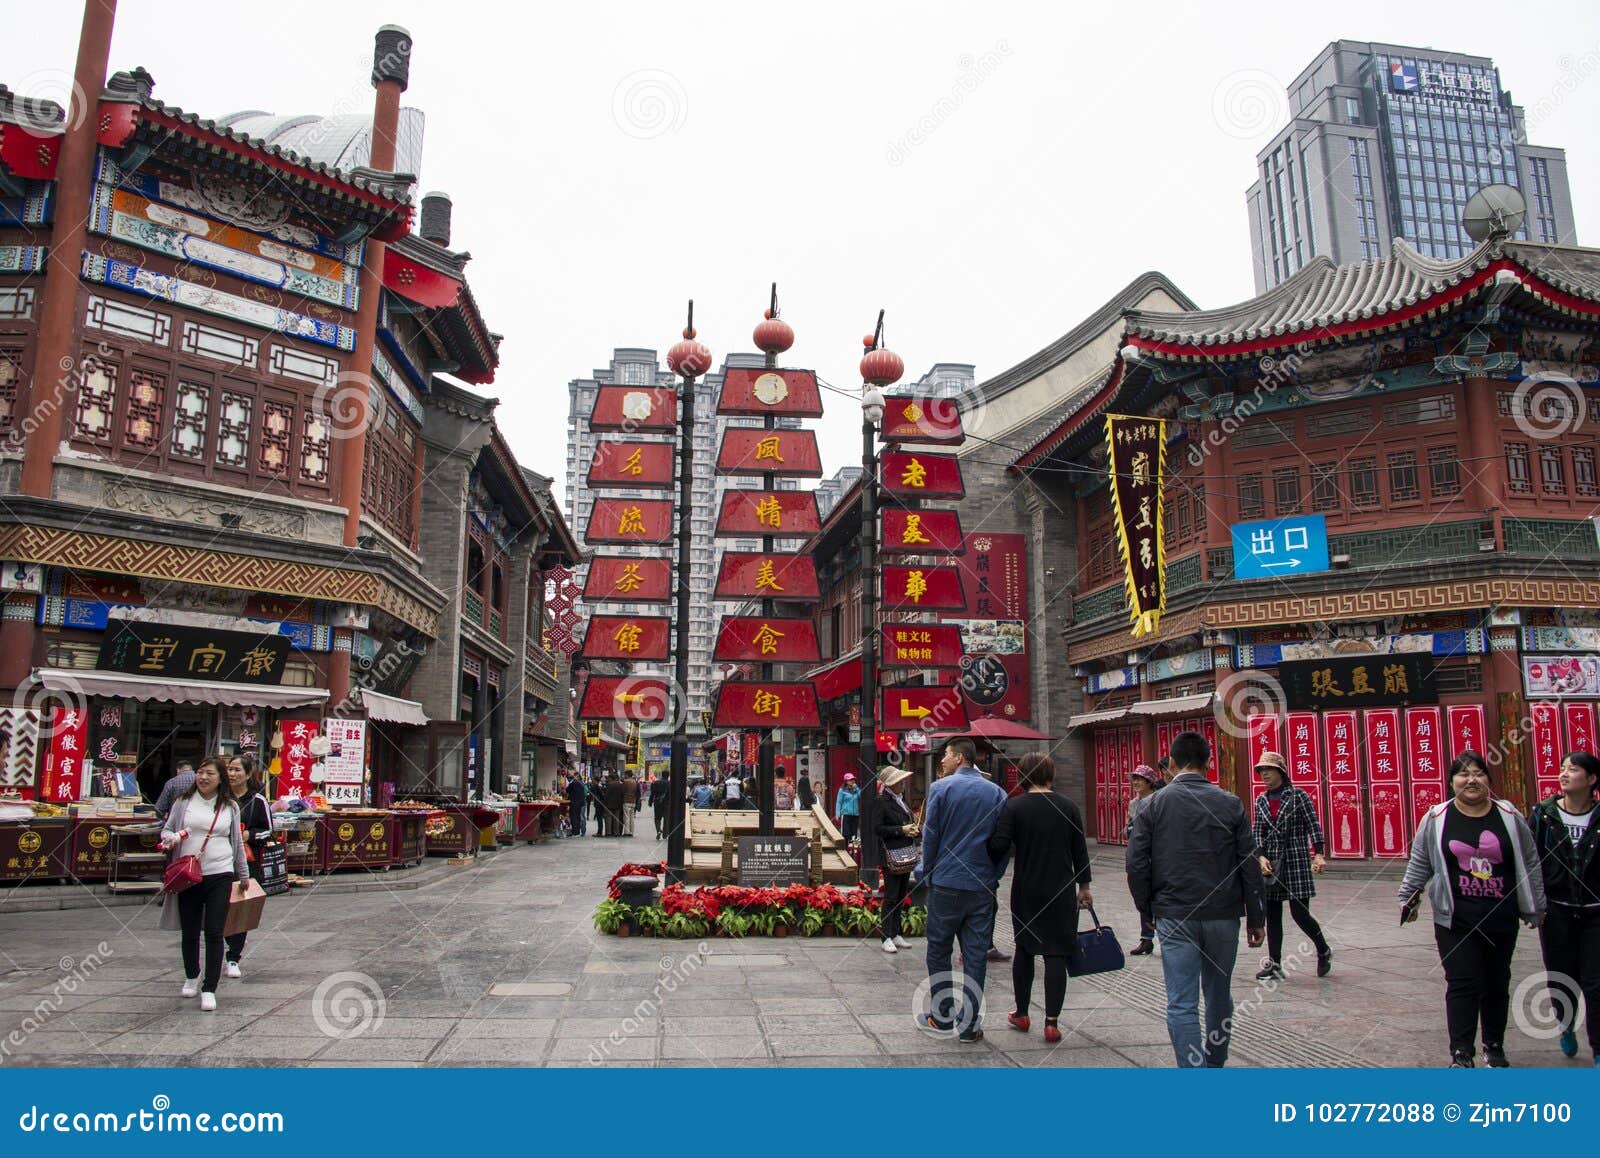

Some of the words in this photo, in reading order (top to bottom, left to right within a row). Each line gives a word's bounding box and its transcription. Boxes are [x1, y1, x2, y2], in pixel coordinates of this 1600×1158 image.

[1251, 526, 1309, 555] 出口
[896, 631, 932, 643] 鞋文化
[896, 648, 933, 660] 博物馆
[57, 709, 80, 801] 安徽宣纸
[1295, 722, 1313, 775] 崩豆张
[1333, 721, 1352, 775] 崩豆张
[1374, 719, 1393, 774] 崩豆张
[1415, 717, 1436, 773] 崩豆张
[1539, 709, 1555, 773] 津门特产
[1575, 711, 1587, 753] 十八街
[287, 722, 310, 800] 安徽宣纸
[1458, 875, 1505, 889] DAISY
[1461, 887, 1504, 899] DUCK
